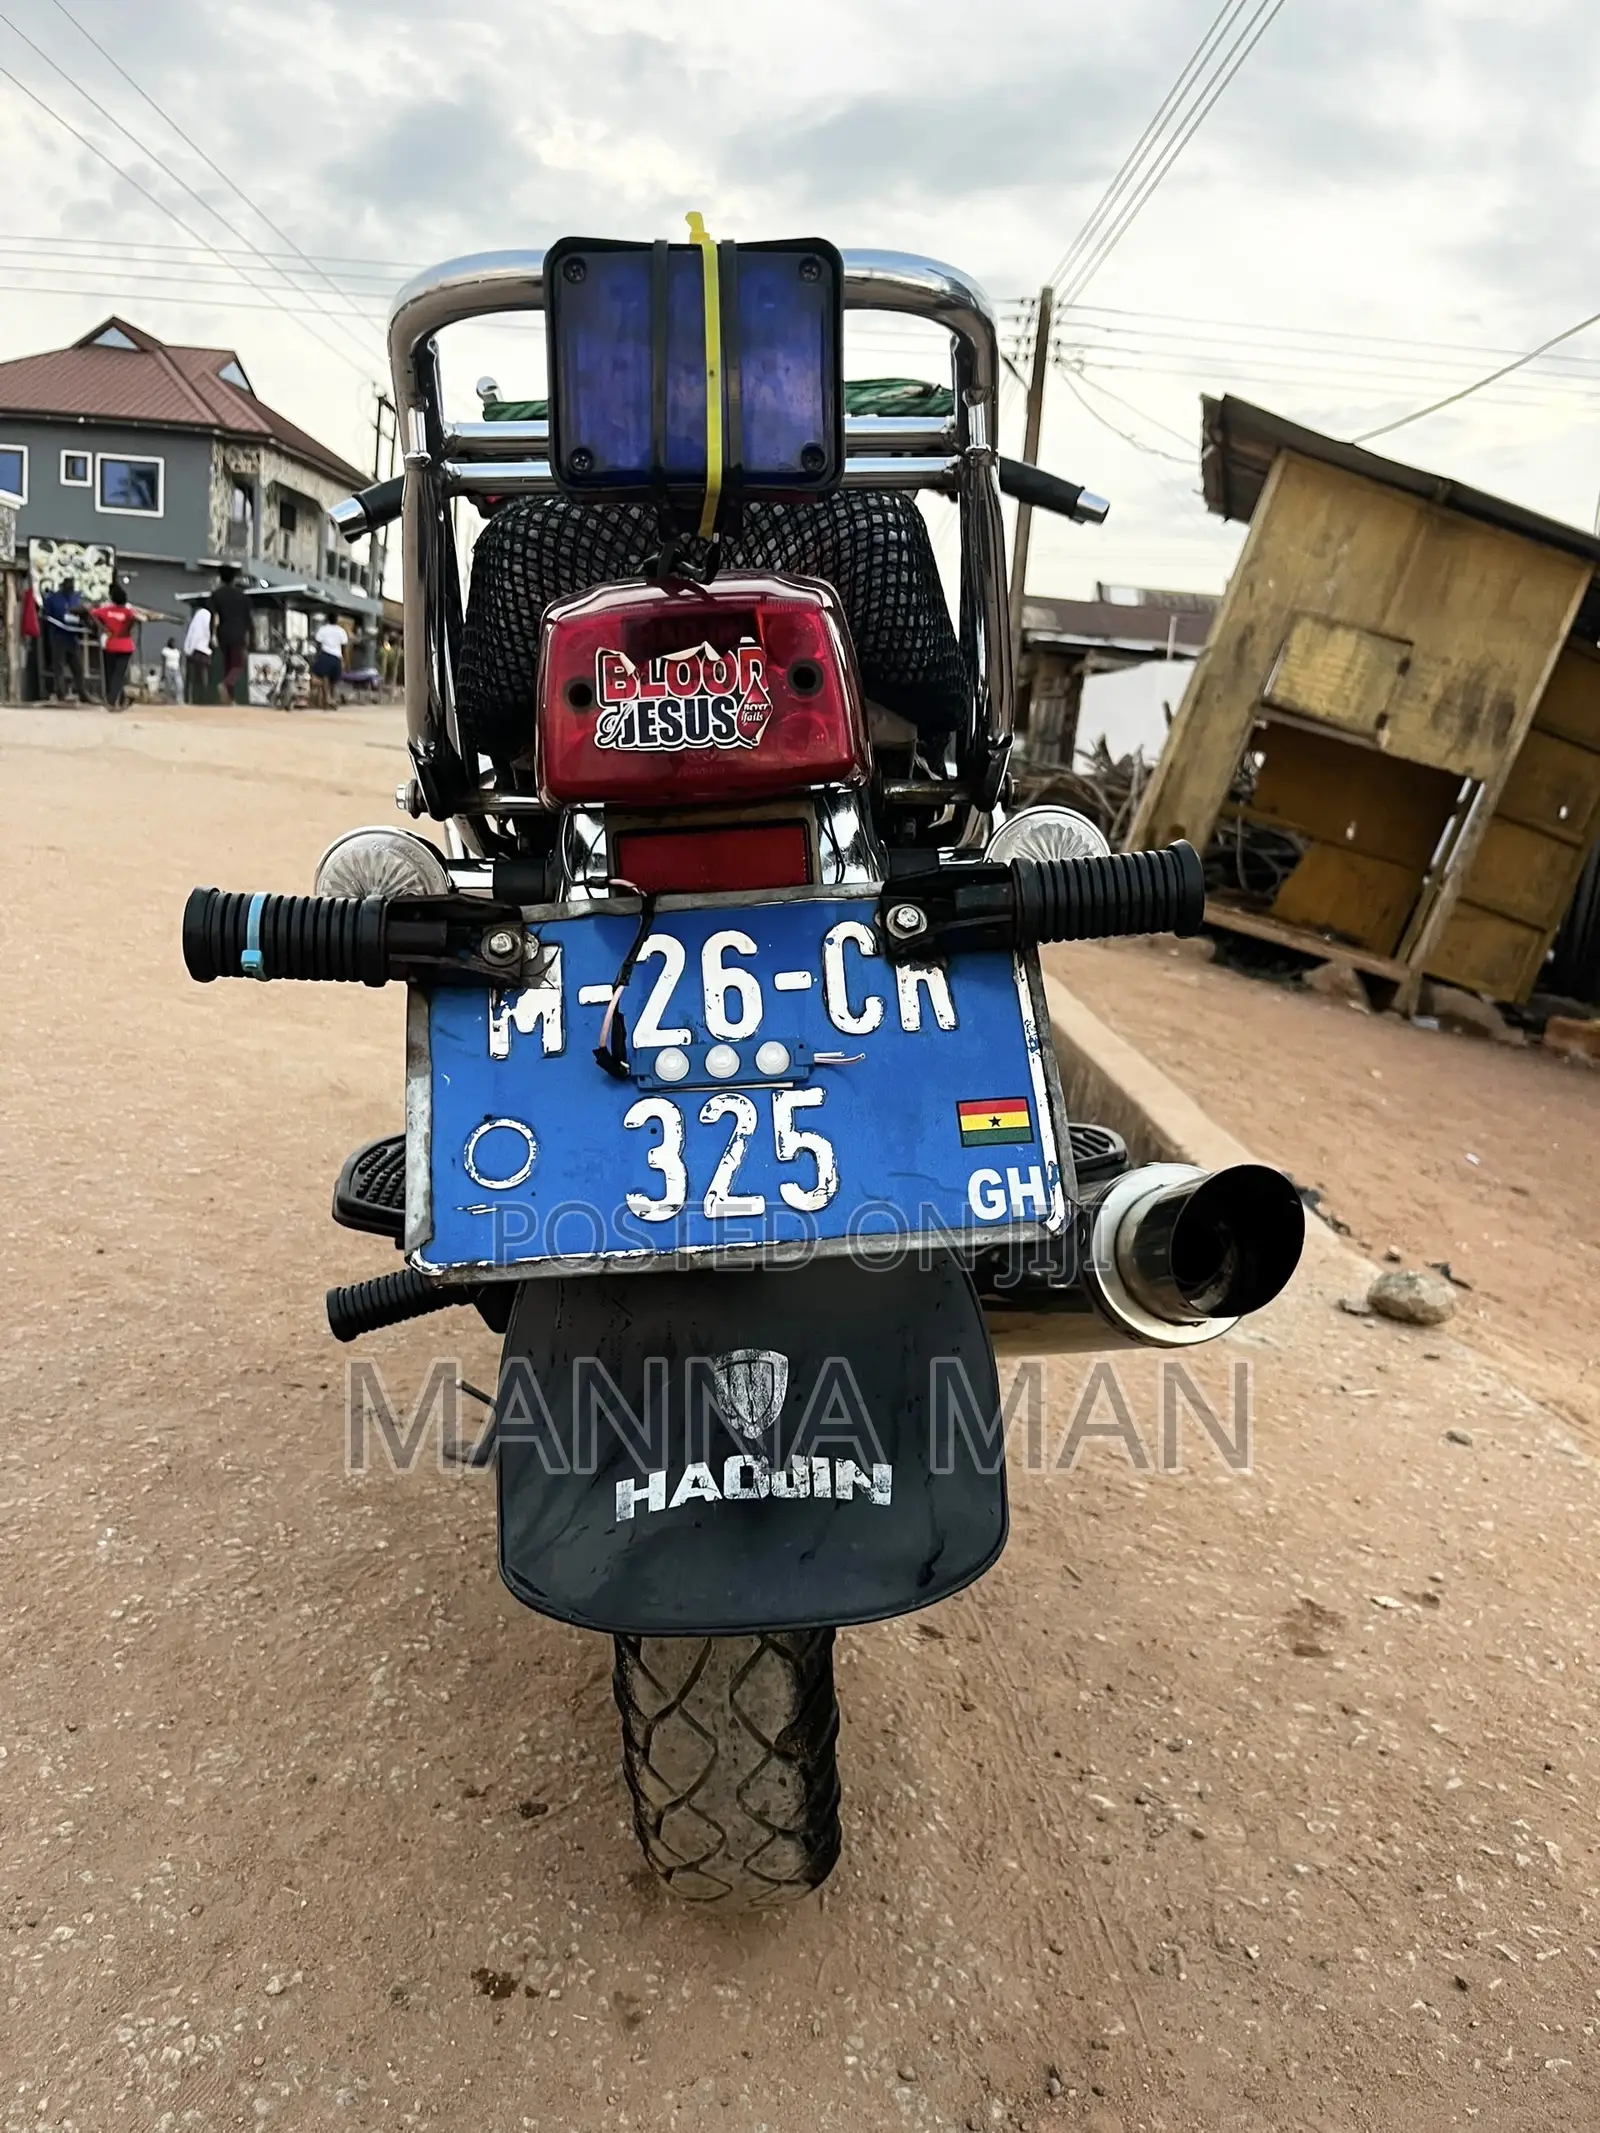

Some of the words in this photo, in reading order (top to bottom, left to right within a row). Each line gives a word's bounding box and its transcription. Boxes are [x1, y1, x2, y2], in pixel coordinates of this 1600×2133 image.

[618, 697, 736, 746] JESUS
[742, 711, 764, 725] fails
[624, 1088, 837, 1221] 325
[968, 1166, 1048, 1220] GH
[615, 1454, 893, 1522] HAOJIN
